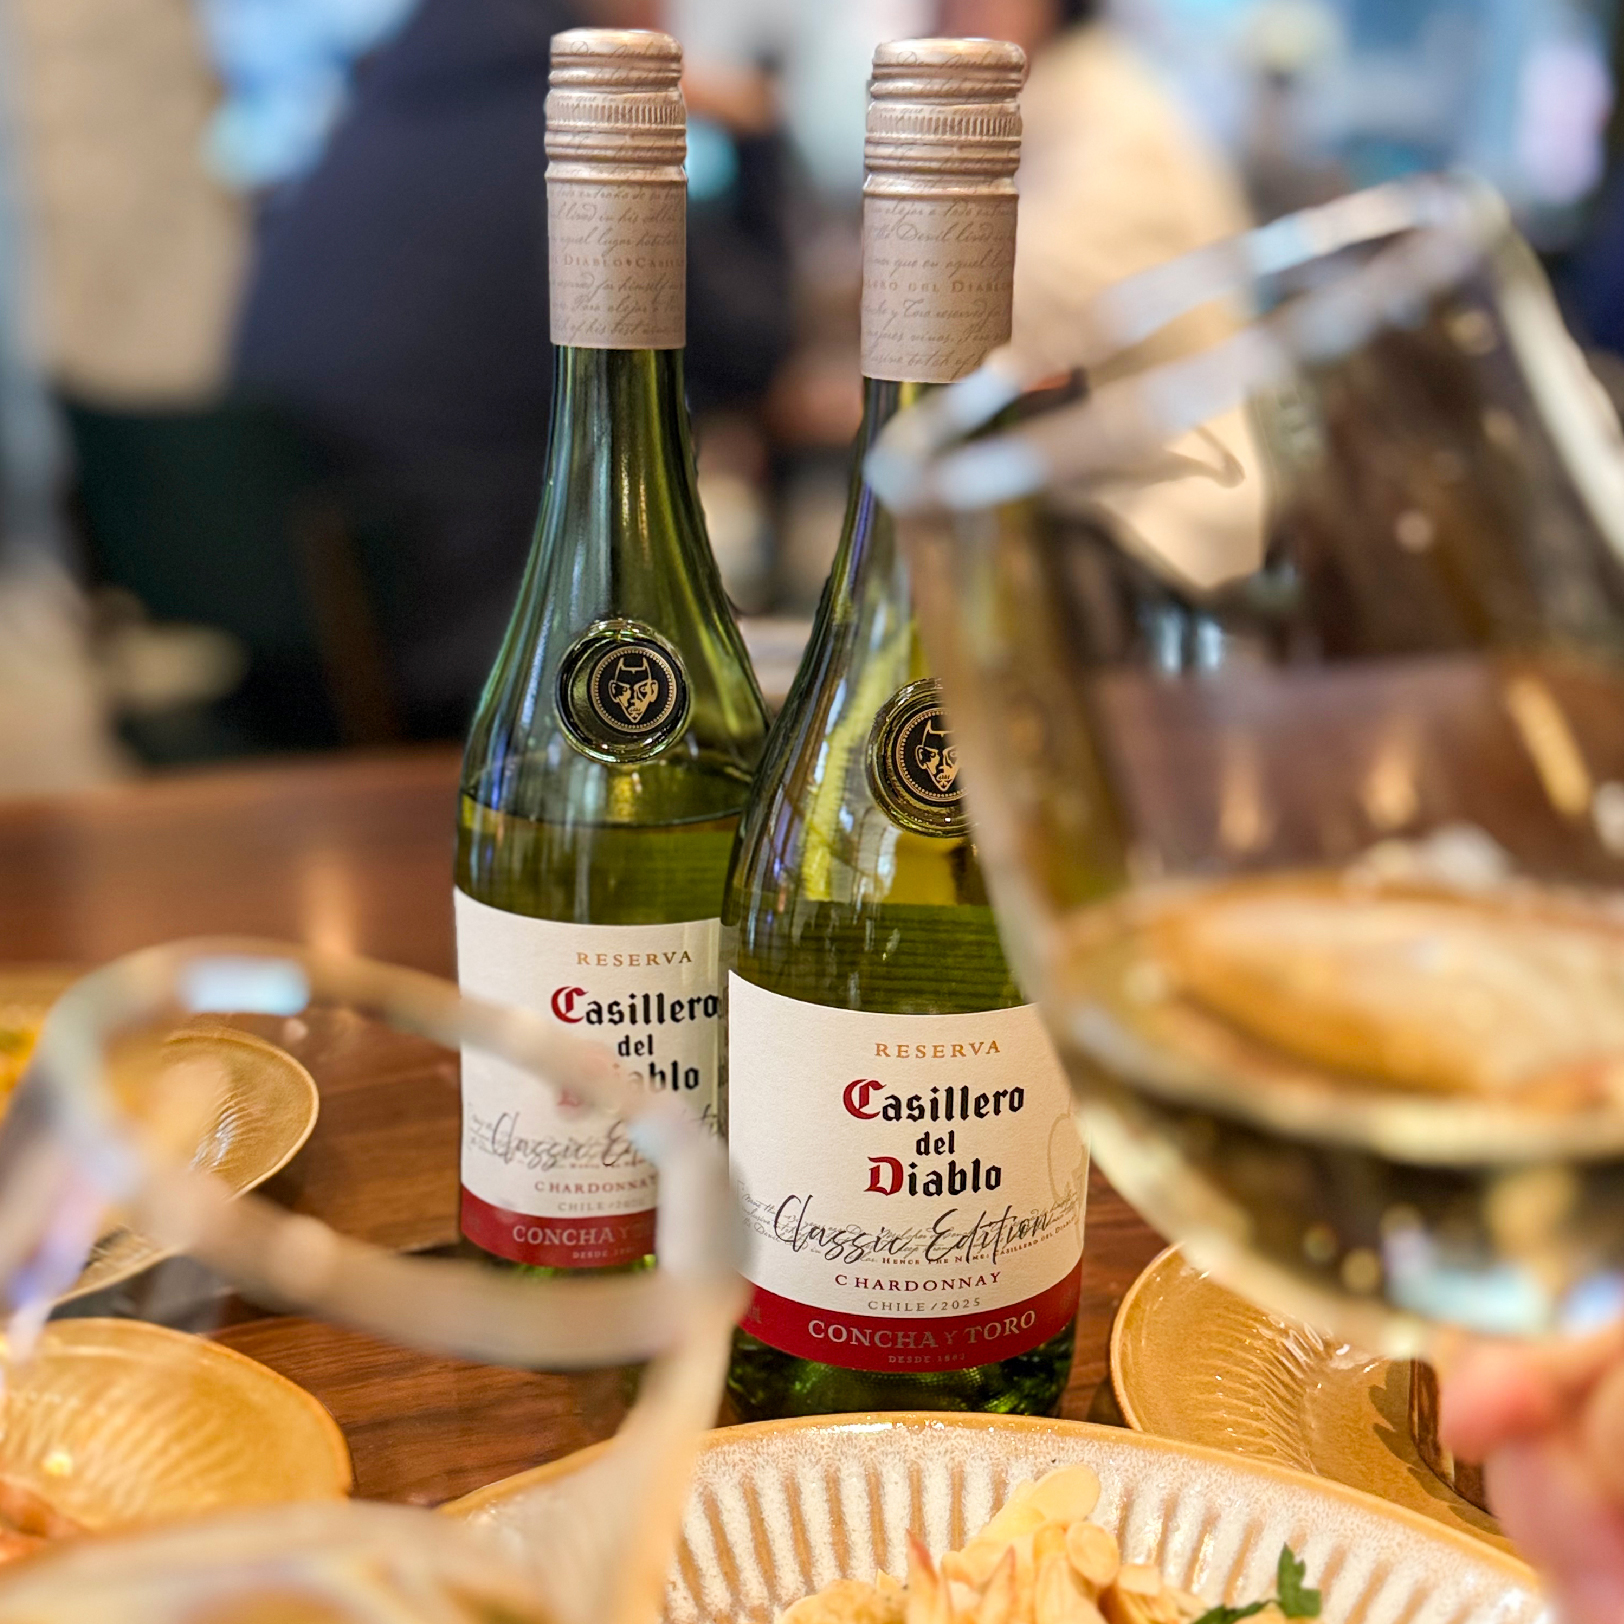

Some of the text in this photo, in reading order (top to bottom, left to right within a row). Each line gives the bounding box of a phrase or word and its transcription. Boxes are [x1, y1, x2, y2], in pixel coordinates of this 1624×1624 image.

[576, 950, 693, 967] RESERVA
[550, 985, 720, 1026] Casillero
[618, 1033, 654, 1057] del
[875, 1040, 1001, 1059] RESERVA
[842, 1078, 1025, 1122] Casillero
[916, 1130, 955, 1156] del
[864, 1156, 1002, 1197] Diablo
[513, 1224, 616, 1246] CONCHA
[774, 1194, 911, 1265] Classic
[925, 1205, 1051, 1265] Edition
[835, 1271, 1002, 1293] CHARDONNAY
[807, 1310, 1036, 1349] CONCHA Y TORO
[888, 1355, 931, 1364] DESDE
